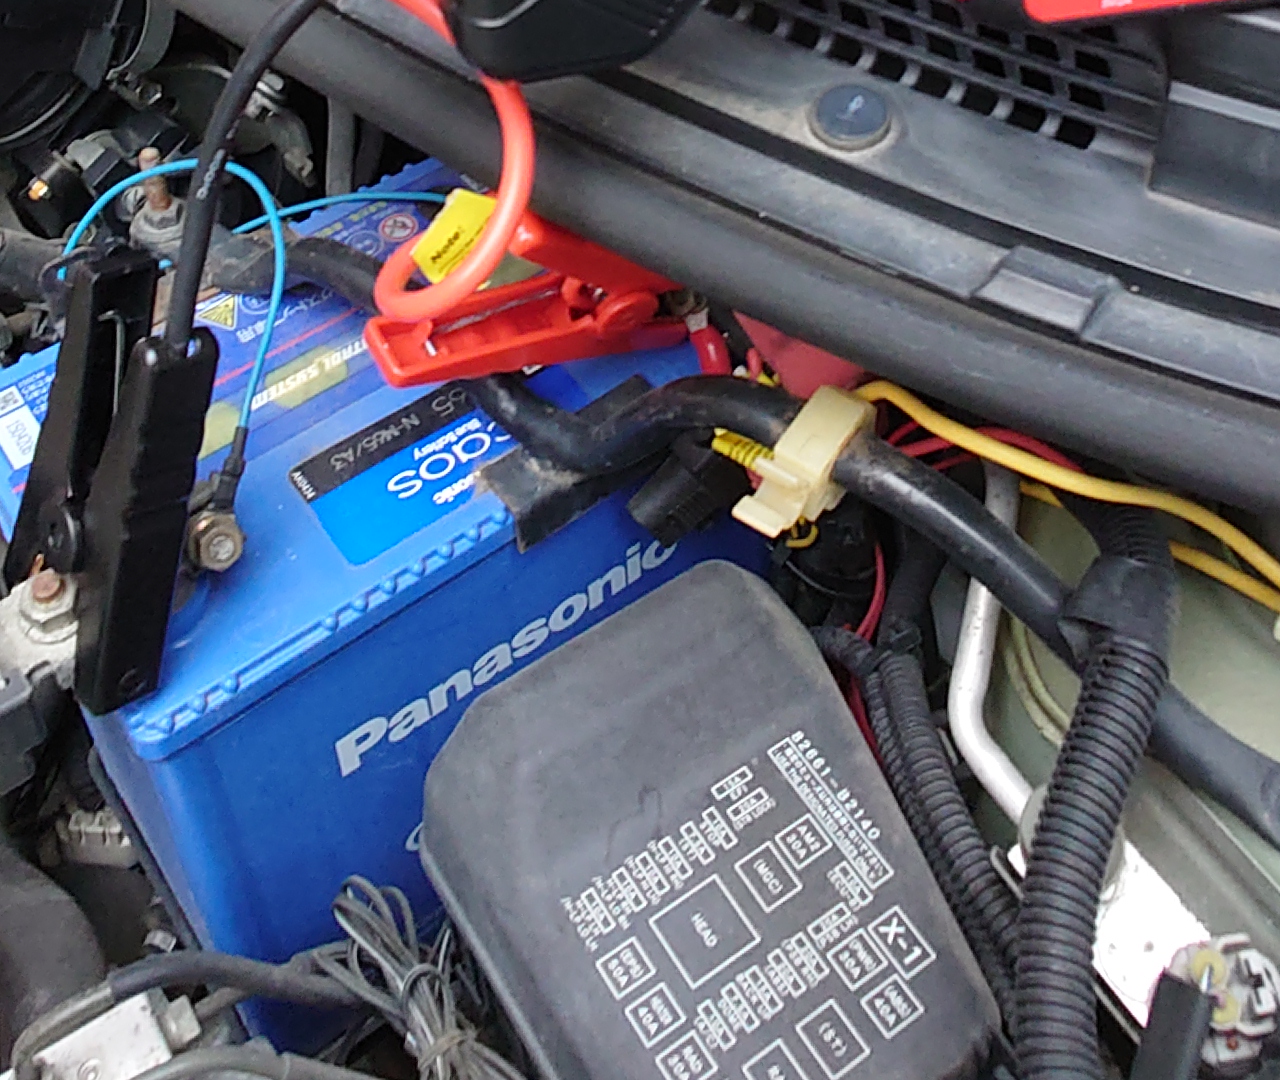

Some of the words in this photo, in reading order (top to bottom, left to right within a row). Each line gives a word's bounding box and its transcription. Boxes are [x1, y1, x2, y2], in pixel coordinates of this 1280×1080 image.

[251, 363, 320, 411] SYSTEM
[333, 540, 676, 777] Panasonic
[784, 831, 810, 860] 30A
[794, 822, 822, 853] AM2
[688, 910, 720, 949] HEAD
[878, 918, 922, 963] X-1
[633, 1003, 662, 1036] 40A
[870, 994, 900, 1027] 40A
[678, 1043, 706, 1075] RAD
